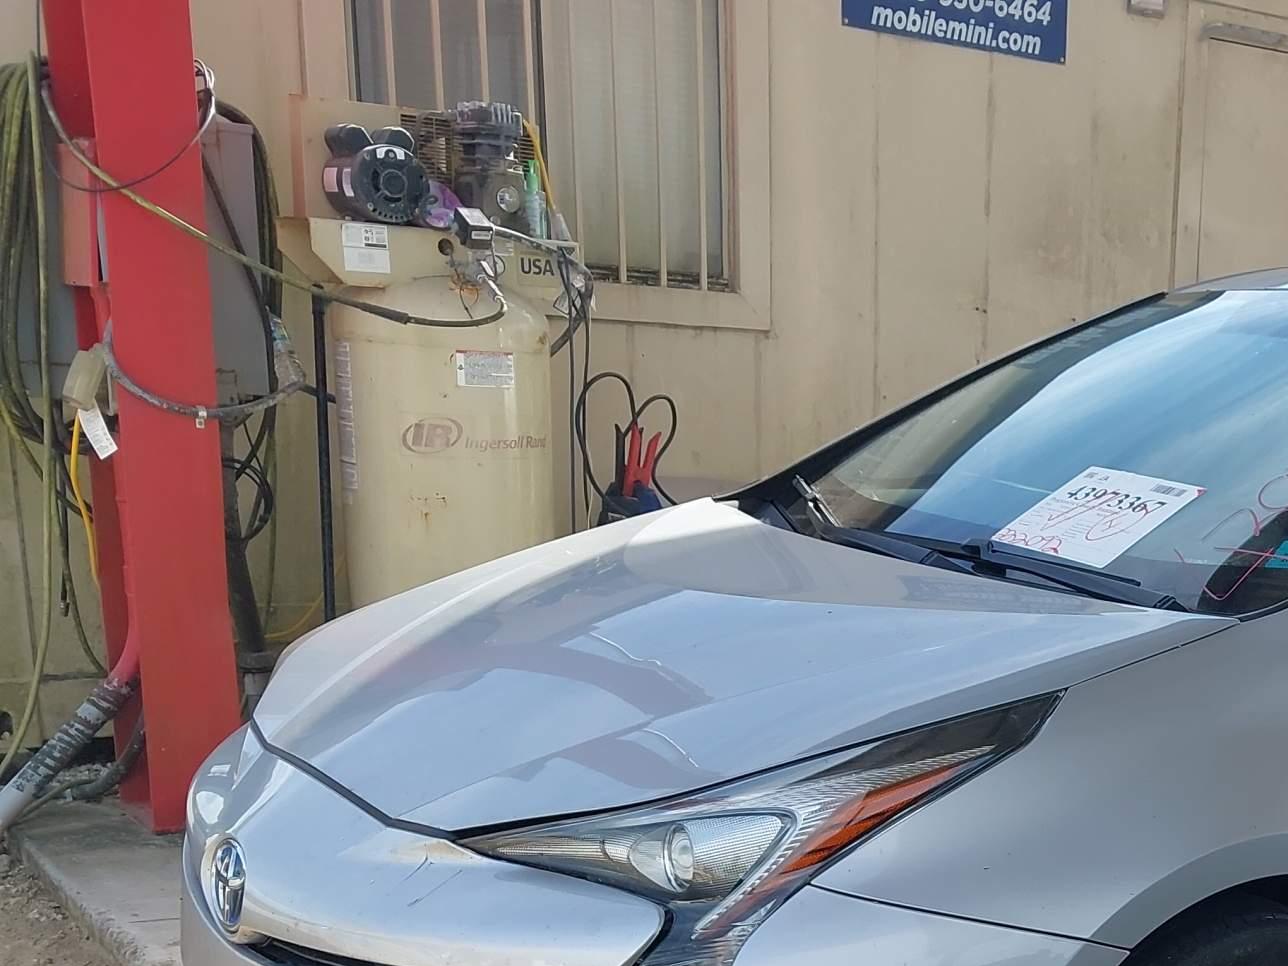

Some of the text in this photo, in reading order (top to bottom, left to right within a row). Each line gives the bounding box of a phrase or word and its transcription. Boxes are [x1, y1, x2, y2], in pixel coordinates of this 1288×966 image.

[871, 6, 1041, 54] mobilemini.com
[520, 257, 555, 276] USA
[465, 435, 547, 452] Ingersoll Rand
[1067, 486, 1167, 513] 43973367
